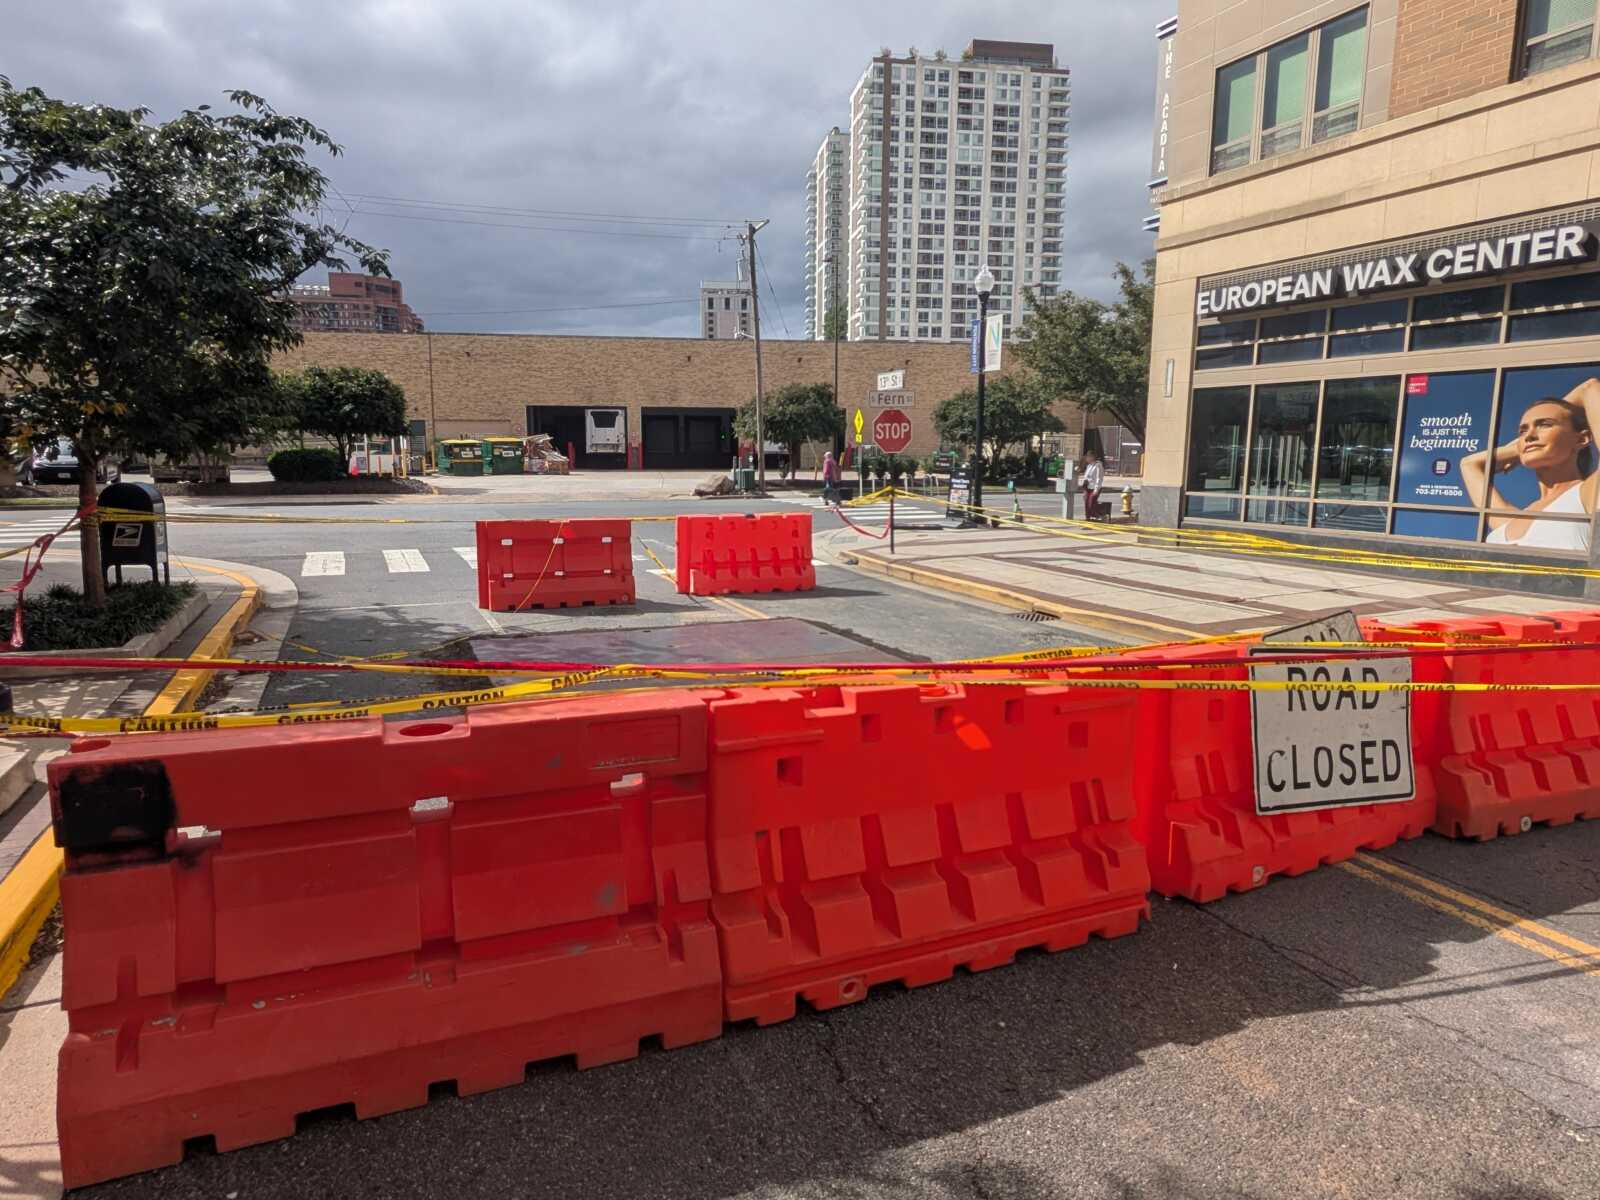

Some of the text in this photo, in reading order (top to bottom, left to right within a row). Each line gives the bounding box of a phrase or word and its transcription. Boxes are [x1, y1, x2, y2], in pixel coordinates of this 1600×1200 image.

[1158, 38, 1175, 173] THE ACADIA
[1196, 225, 1585, 316] EUROPEAN WAX CENTER
[878, 392, 905, 405] Fern
[876, 423, 910, 440] STOP
[1420, 412, 1472, 427] smooth
[1422, 428, 1468, 436] IS JUST THE
[1410, 435, 1479, 452] beginning
[1287, 665, 1381, 712] ROAD
[120, 718, 219, 733] CAUTION
[278, 709, 369, 725] CAUTION
[422, 690, 505, 710] CAUTION
[1267, 739, 1402, 793] CLOSED
